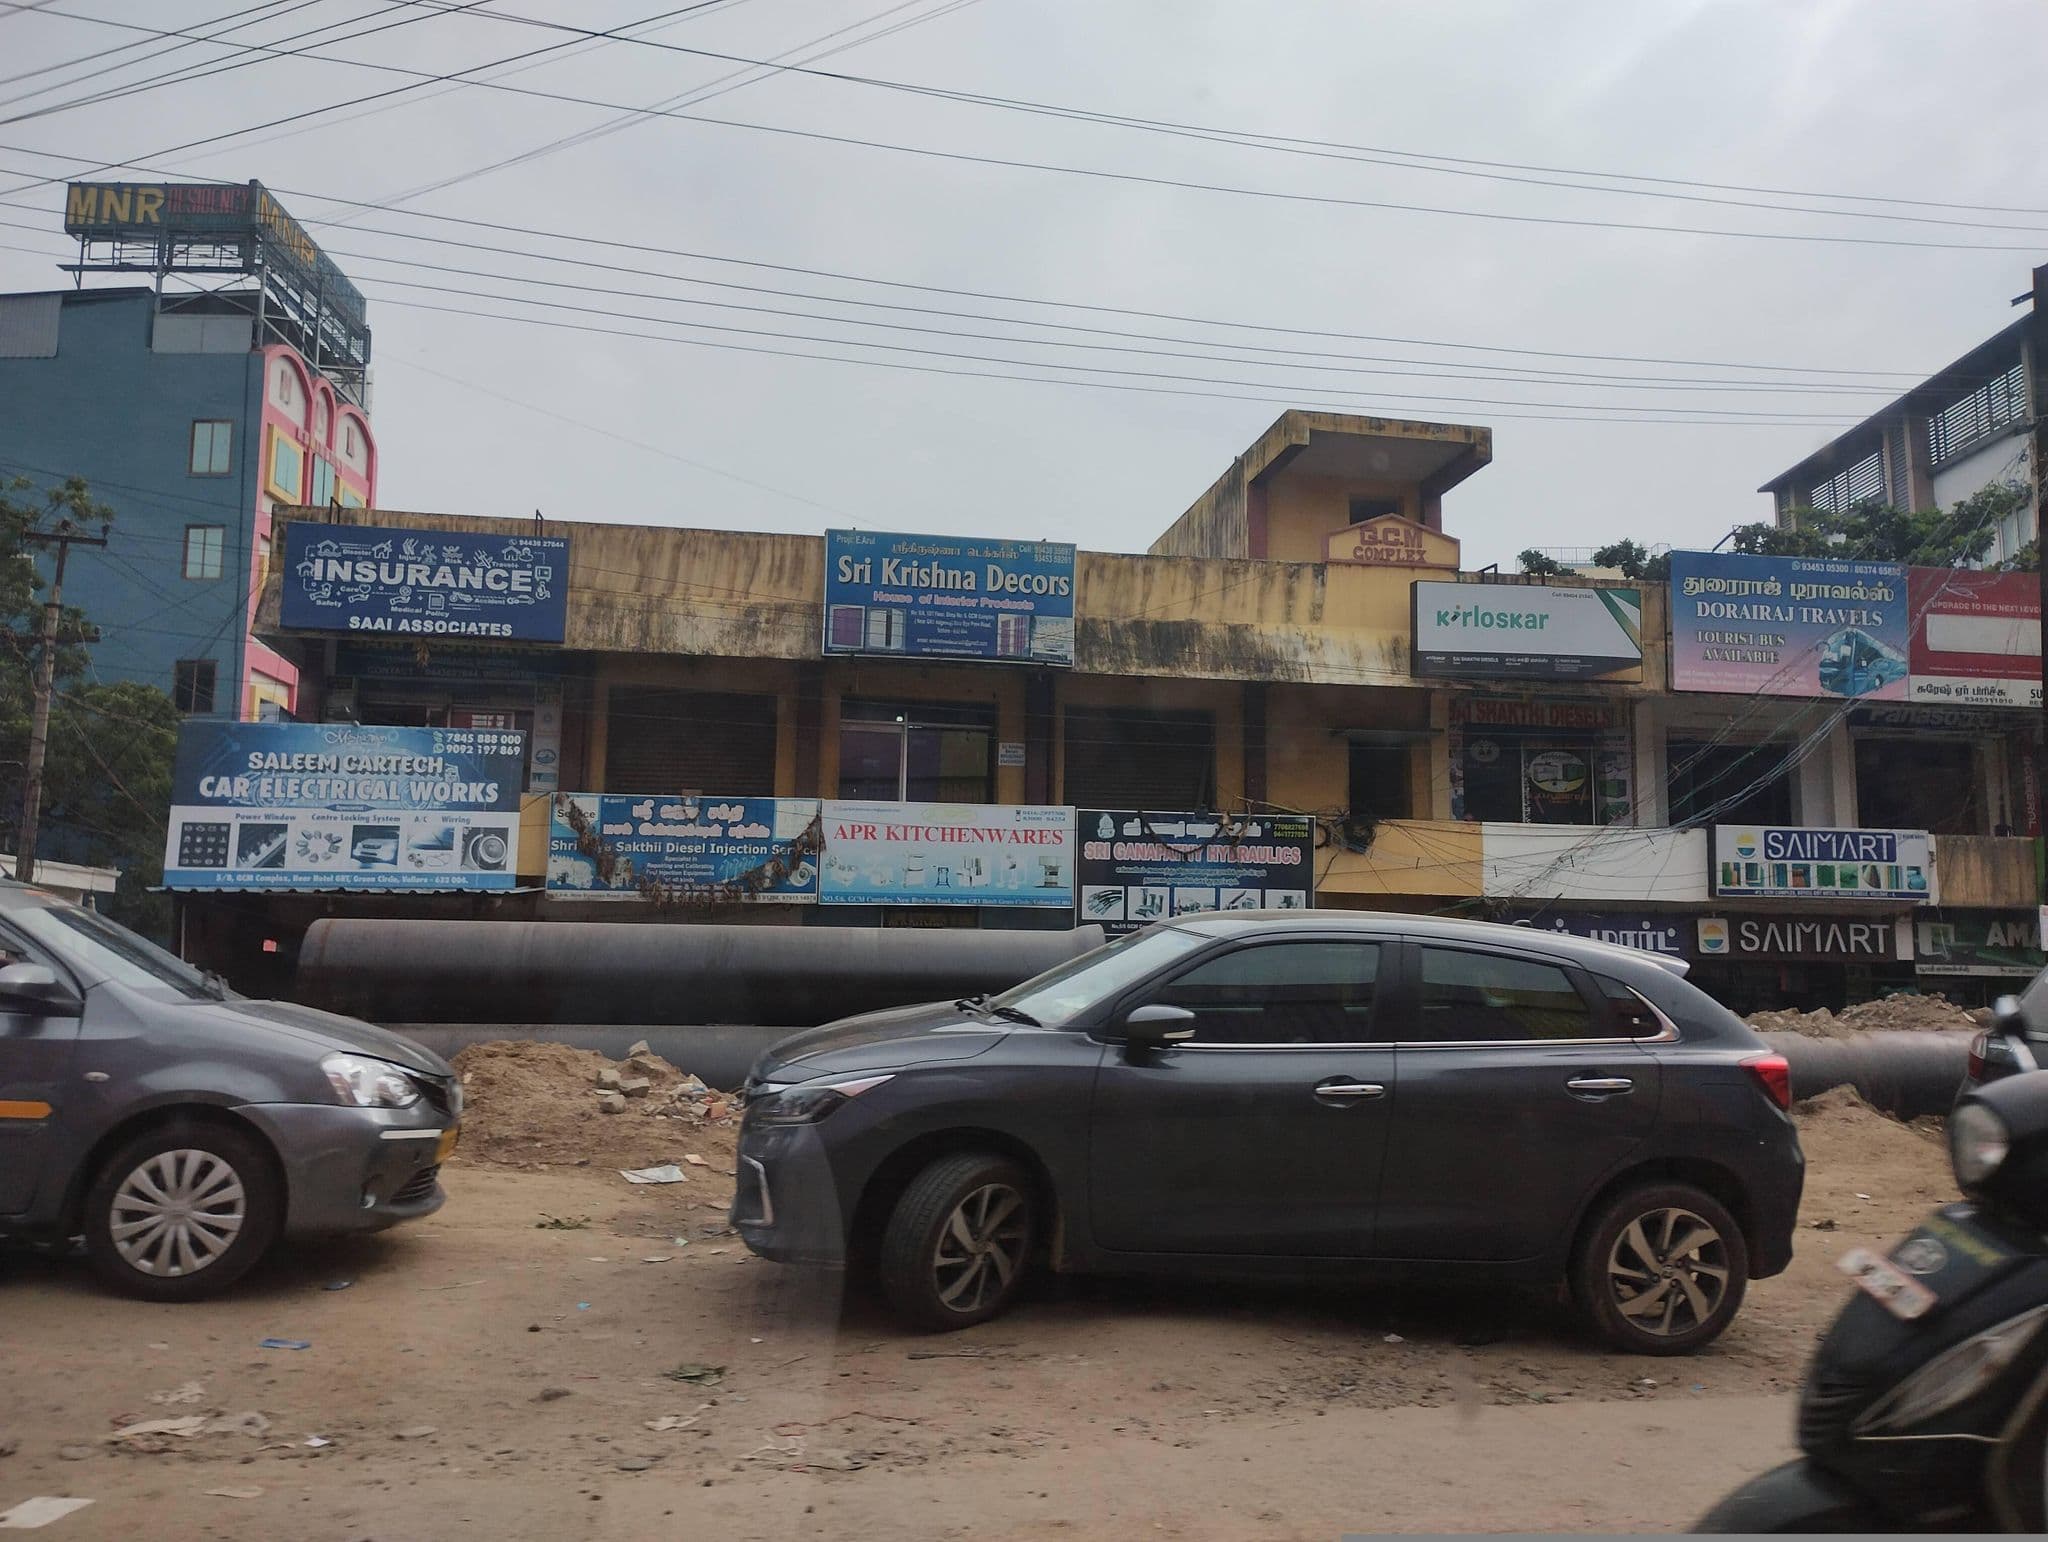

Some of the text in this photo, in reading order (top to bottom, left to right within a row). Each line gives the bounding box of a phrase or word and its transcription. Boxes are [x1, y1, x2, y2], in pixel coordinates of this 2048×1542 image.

[68, 186, 249, 224] MNR RESIDENCY
[260, 193, 317, 266] MNR
[399, 554, 421, 562] Injury
[444, 557, 462, 565] Risk
[1352, 546, 1427, 563] COMPLEX
[313, 558, 533, 592] INSURANCE
[838, 556, 1070, 596] Sri Krishna Decors
[340, 585, 359, 593] Care
[1682, 576, 1895, 602] துரைராஜ் டிராவல்ஸ்
[316, 599, 343, 609] Safety
[873, 590, 1034, 611] House of Interior Products
[1931, 601, 1969, 610] UPGRADE
[1999, 604, 2018, 612] NEXT
[390, 606, 450, 619] Medical Policy
[1696, 601, 1884, 627] DORAIRAJ TRAVELS
[349, 616, 514, 637] SAAI ASSOCIATES
[1697, 630, 1785, 647] TOURIST BUS
[1703, 648, 1779, 664] AVAILABLE
[446, 733, 474, 743] 7845
[500, 735, 522, 745] 000
[446, 745, 521, 756] 9092 197 869
[248, 752, 444, 776] SALEEM CARTECH
[199, 775, 499, 803] CAR ELECTRICAL WORKS
[235, 812, 296, 821] Power Window
[311, 813, 401, 824] Centre Locking System
[557, 809, 596, 819] Sece
[834, 823, 1063, 846] APR KITCHENWARES
[551, 840, 577, 851] Shri
[616, 841, 662, 853] Sakthii
[666, 842, 706, 854] Diesel
[709, 843, 767, 857] Injection
[771, 845, 817, 856] Serce
[1084, 841, 1110, 861] SRI
[1206, 844, 1302, 865] HYDRAULICS
[1767, 832, 1894, 861] SAIMART
[1740, 922, 1890, 954] SAIMART
